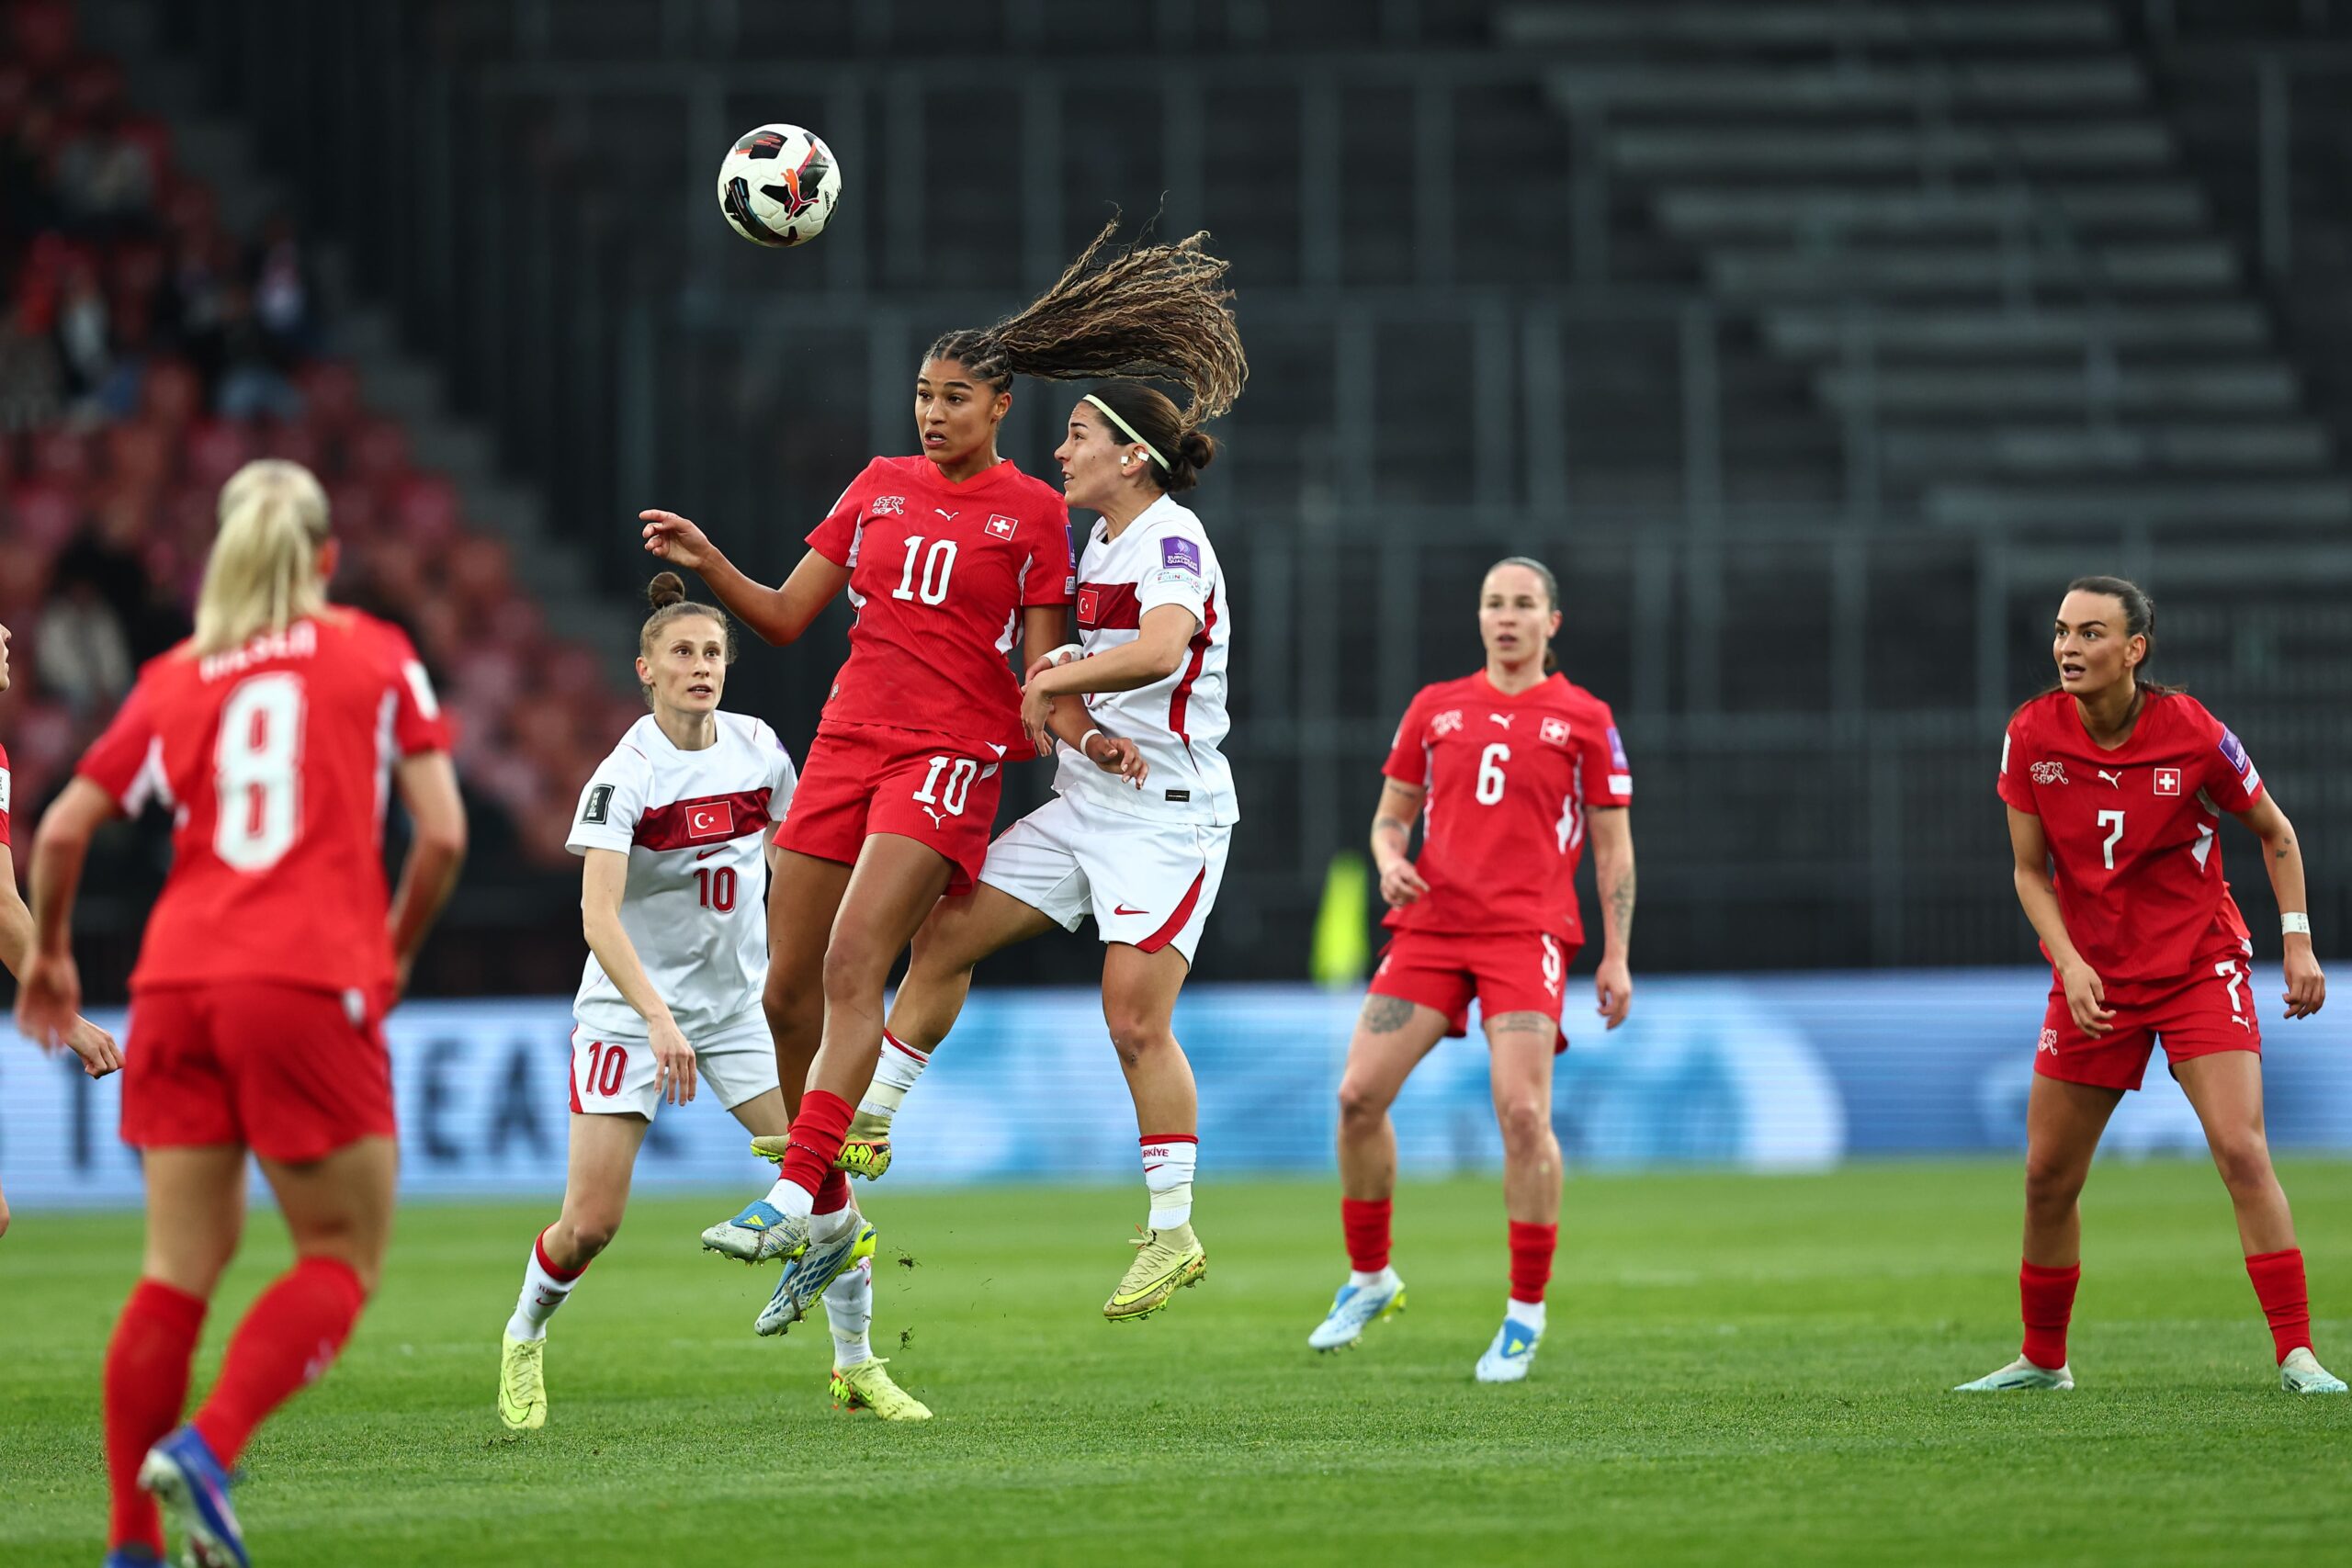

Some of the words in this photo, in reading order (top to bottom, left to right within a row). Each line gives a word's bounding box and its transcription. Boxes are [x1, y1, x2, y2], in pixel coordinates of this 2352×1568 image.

[892, 536, 958, 605] 10
[212, 671, 309, 877] 8
[912, 756, 978, 816] 10
[1476, 742, 1511, 806] 6
[2098, 809, 2126, 870] 7
[693, 866, 738, 914] 10
[2214, 959, 2243, 1012] 7
[585, 1040, 628, 1099] 10
